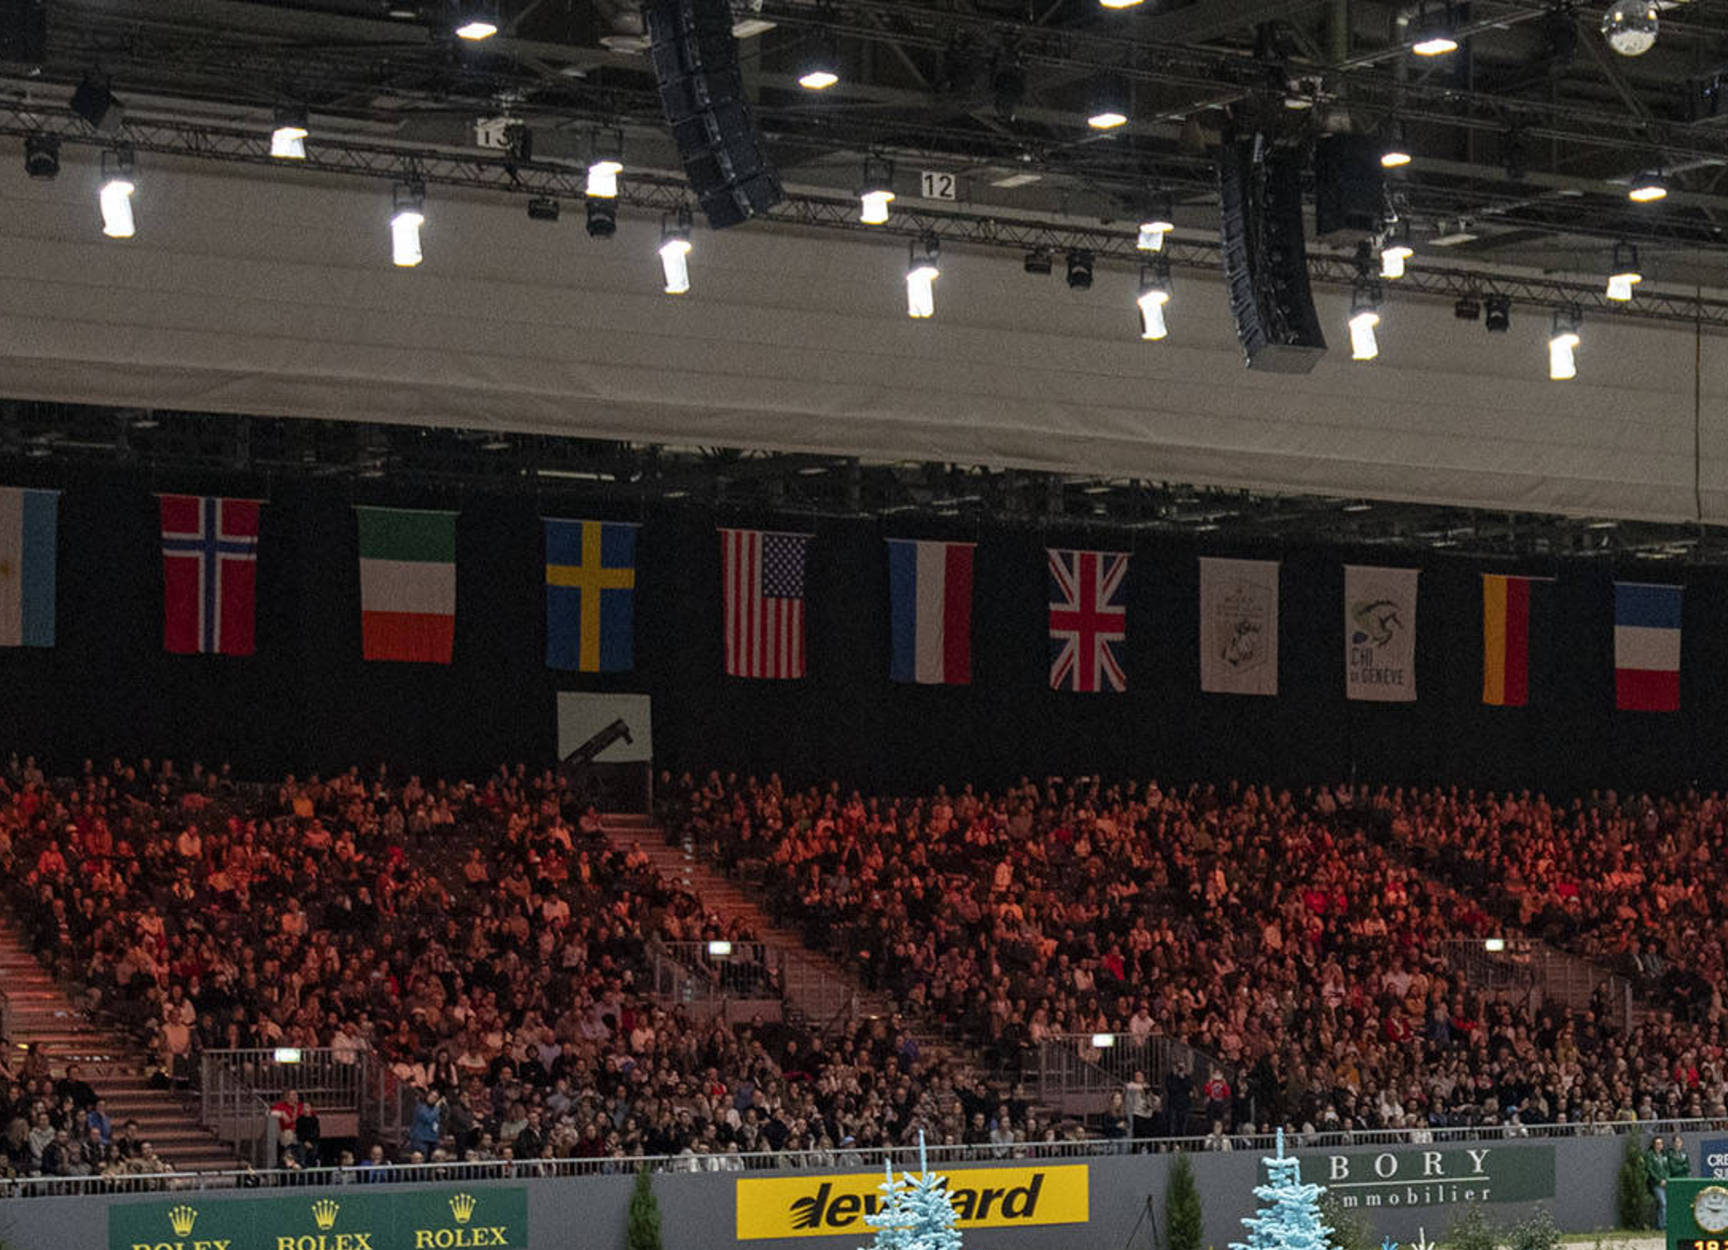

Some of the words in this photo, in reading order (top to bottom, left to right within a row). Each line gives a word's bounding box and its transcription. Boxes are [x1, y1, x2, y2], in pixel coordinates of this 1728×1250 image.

[924, 174, 953, 198] 12
[789, 1172, 1045, 1230] devard
[414, 1226, 509, 1250] ROLEX
